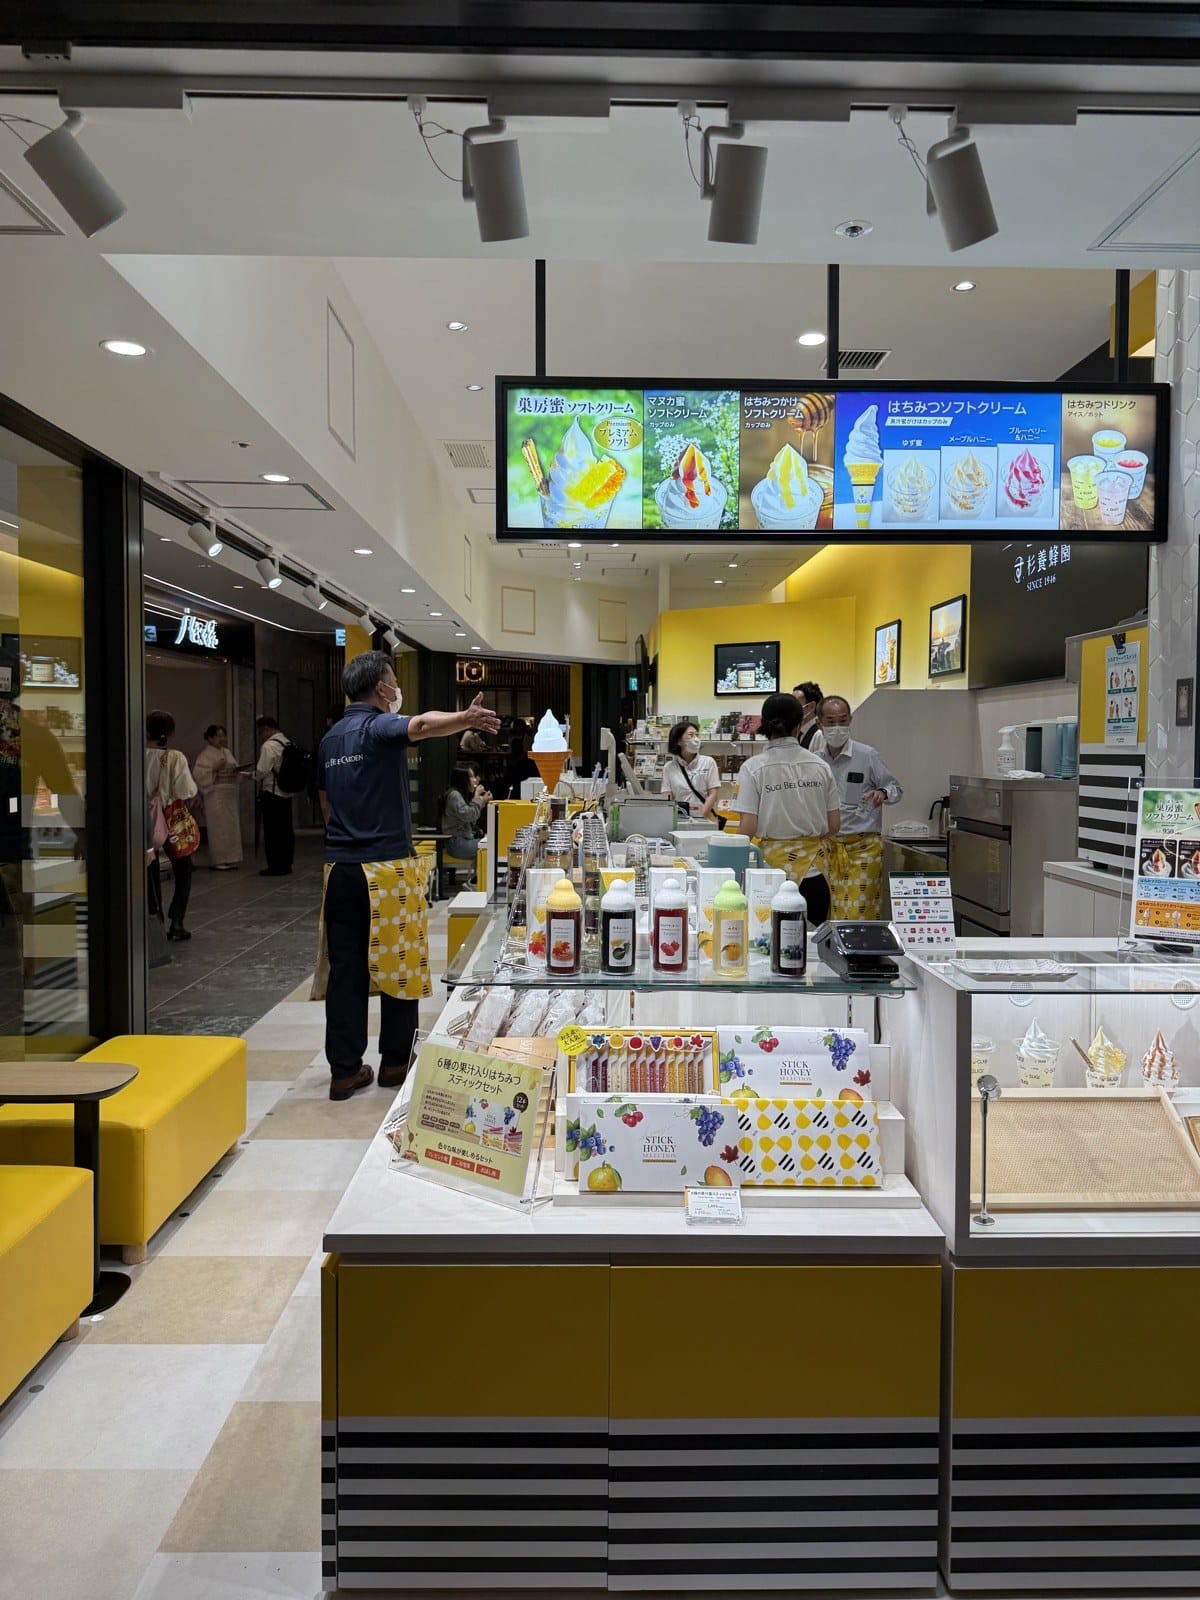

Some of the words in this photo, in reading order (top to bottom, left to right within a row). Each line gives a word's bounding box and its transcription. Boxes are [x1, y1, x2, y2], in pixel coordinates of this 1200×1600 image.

[648, 397, 685, 407] マヌカ蜜
[744, 397, 797, 407] はちみつかけ
[1067, 400, 1137, 410] はちみつドリンク
[567, 402, 634, 414] ソフトクリーム
[888, 400, 1027, 415] はちみつソフトクリーム
[649, 409, 707, 419] ソフトクリーム
[744, 409, 804, 419] ソフトクリーム
[600, 429, 638, 438] プレミアム
[608, 438, 629, 447] ソフト
[902, 439, 923, 447] ゆず蜜
[949, 435, 992, 443] メープルハニー
[1026, 578, 1043, 592] SINCE
[1044, 573, 1057, 586] 1946
[765, 784, 782, 793] SUGI
[782, 1060, 808, 1068] STICK
[437, 1057, 521, 1086] 6種の果汁入りはちみつ
[780, 1068, 812, 1076] HONEY
[448, 1073, 503, 1095] スティックセット
[645, 1136, 673, 1144] STICK
[643, 1144, 677, 1152] HONEY
